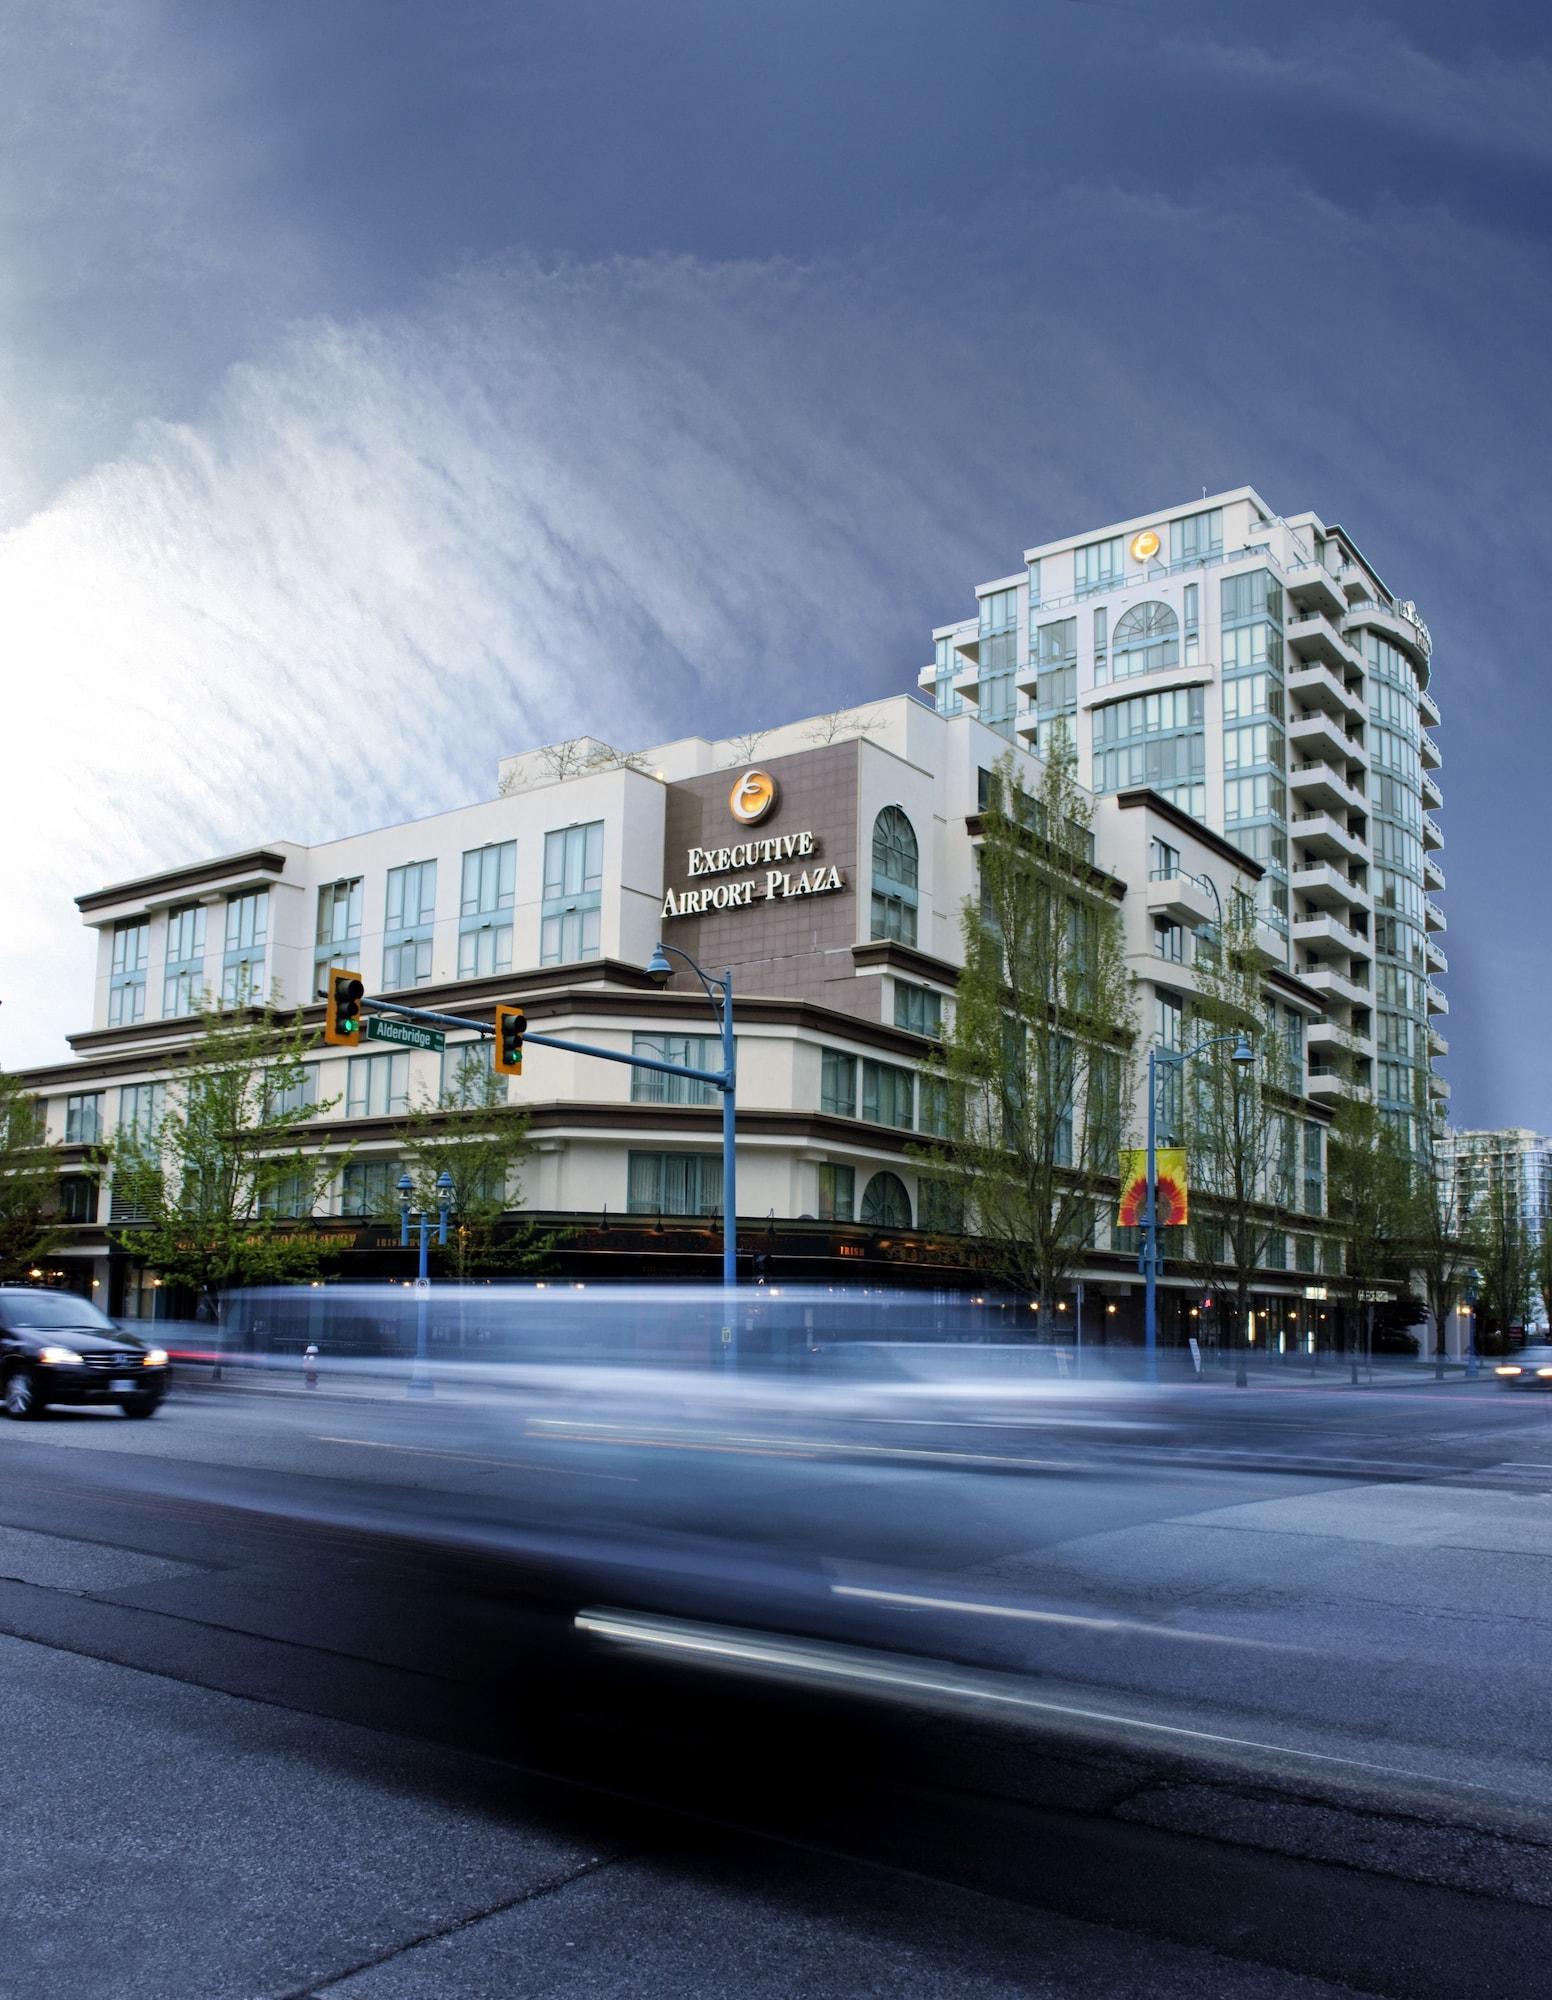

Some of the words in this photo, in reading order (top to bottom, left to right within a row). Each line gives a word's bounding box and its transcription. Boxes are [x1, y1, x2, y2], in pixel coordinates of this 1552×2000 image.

[687, 831, 813, 877] EXECUTIVE
[660, 880, 756, 918] AIRPORT
[766, 865, 843, 900] PLAZA
[376, 1022, 431, 1047] Alderbridge
